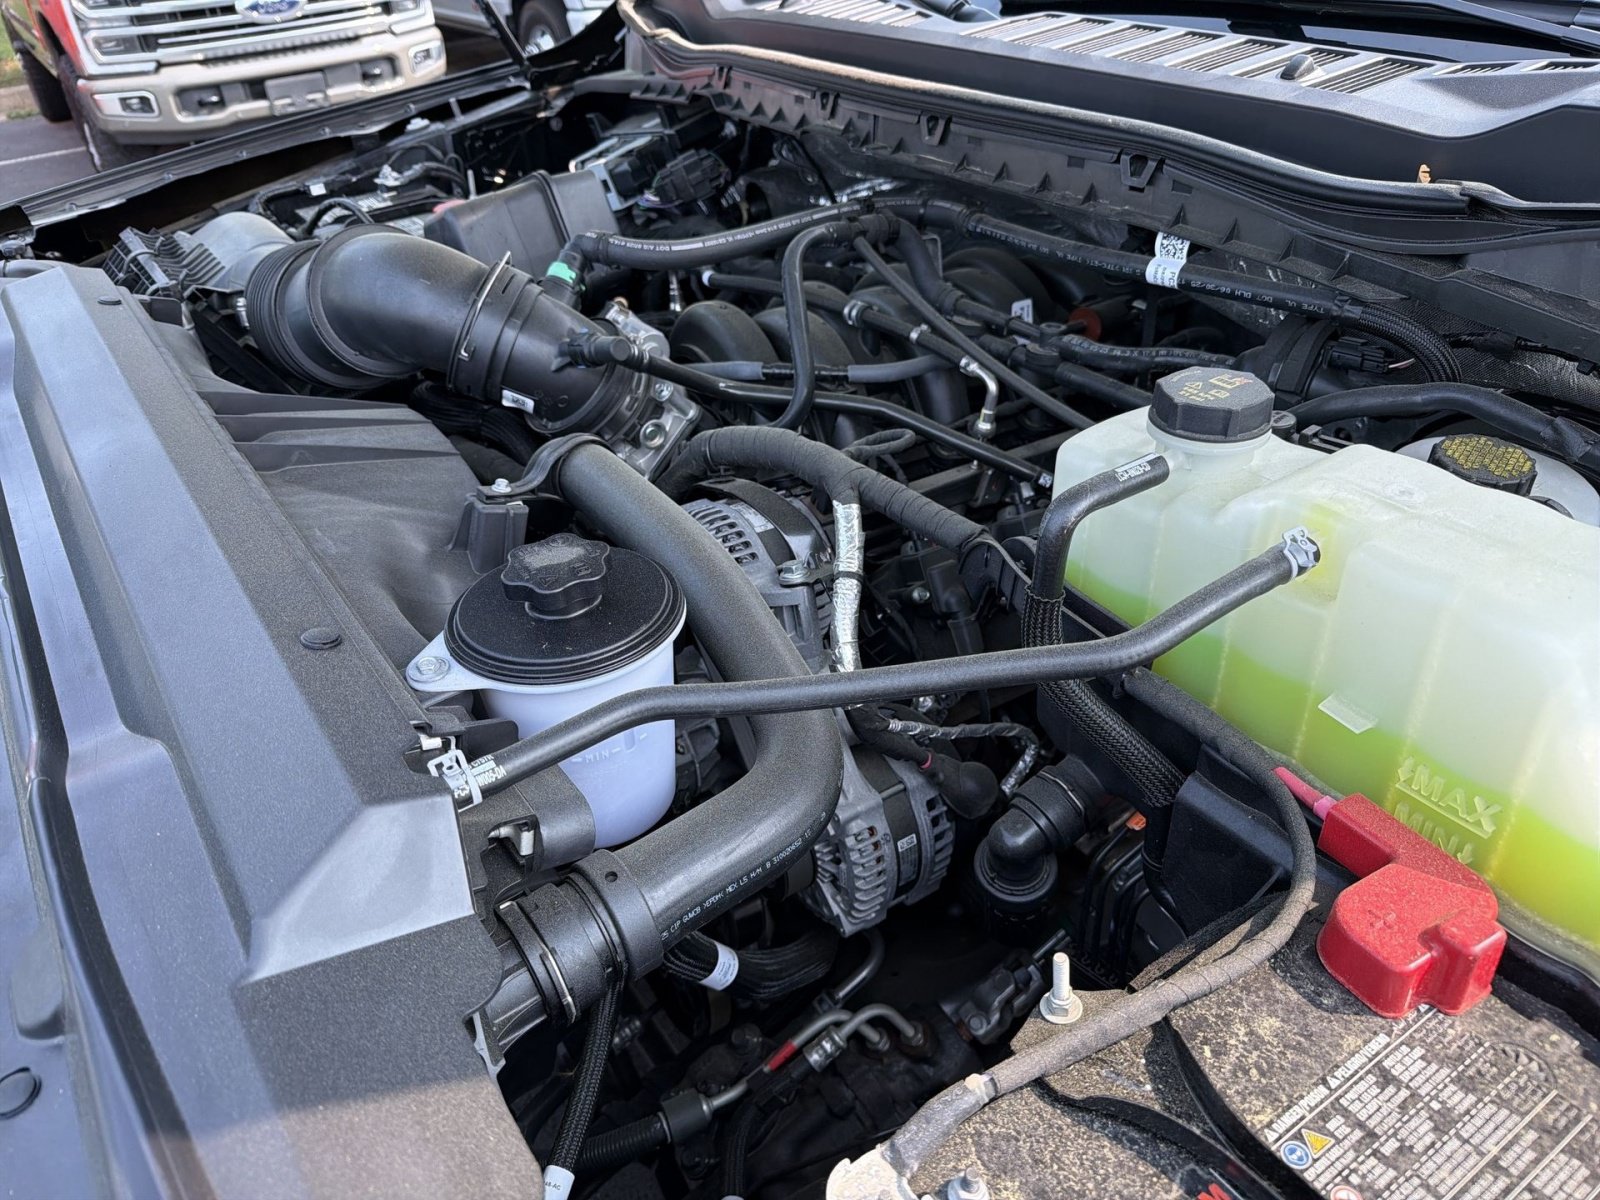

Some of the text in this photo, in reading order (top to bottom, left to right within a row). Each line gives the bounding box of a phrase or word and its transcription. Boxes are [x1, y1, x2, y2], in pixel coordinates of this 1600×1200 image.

[1300, 302, 1326, 314] TYPE
[585, 749, 610, 764] MIN
[1411, 764, 1503, 834] MAX
[668, 919, 684, 933] CIP
[725, 882, 739, 894] MEX
[1272, 1084, 1330, 1135] DANGER/POISON
[1334, 1032, 1390, 1081] PELIGRO/VENENO
